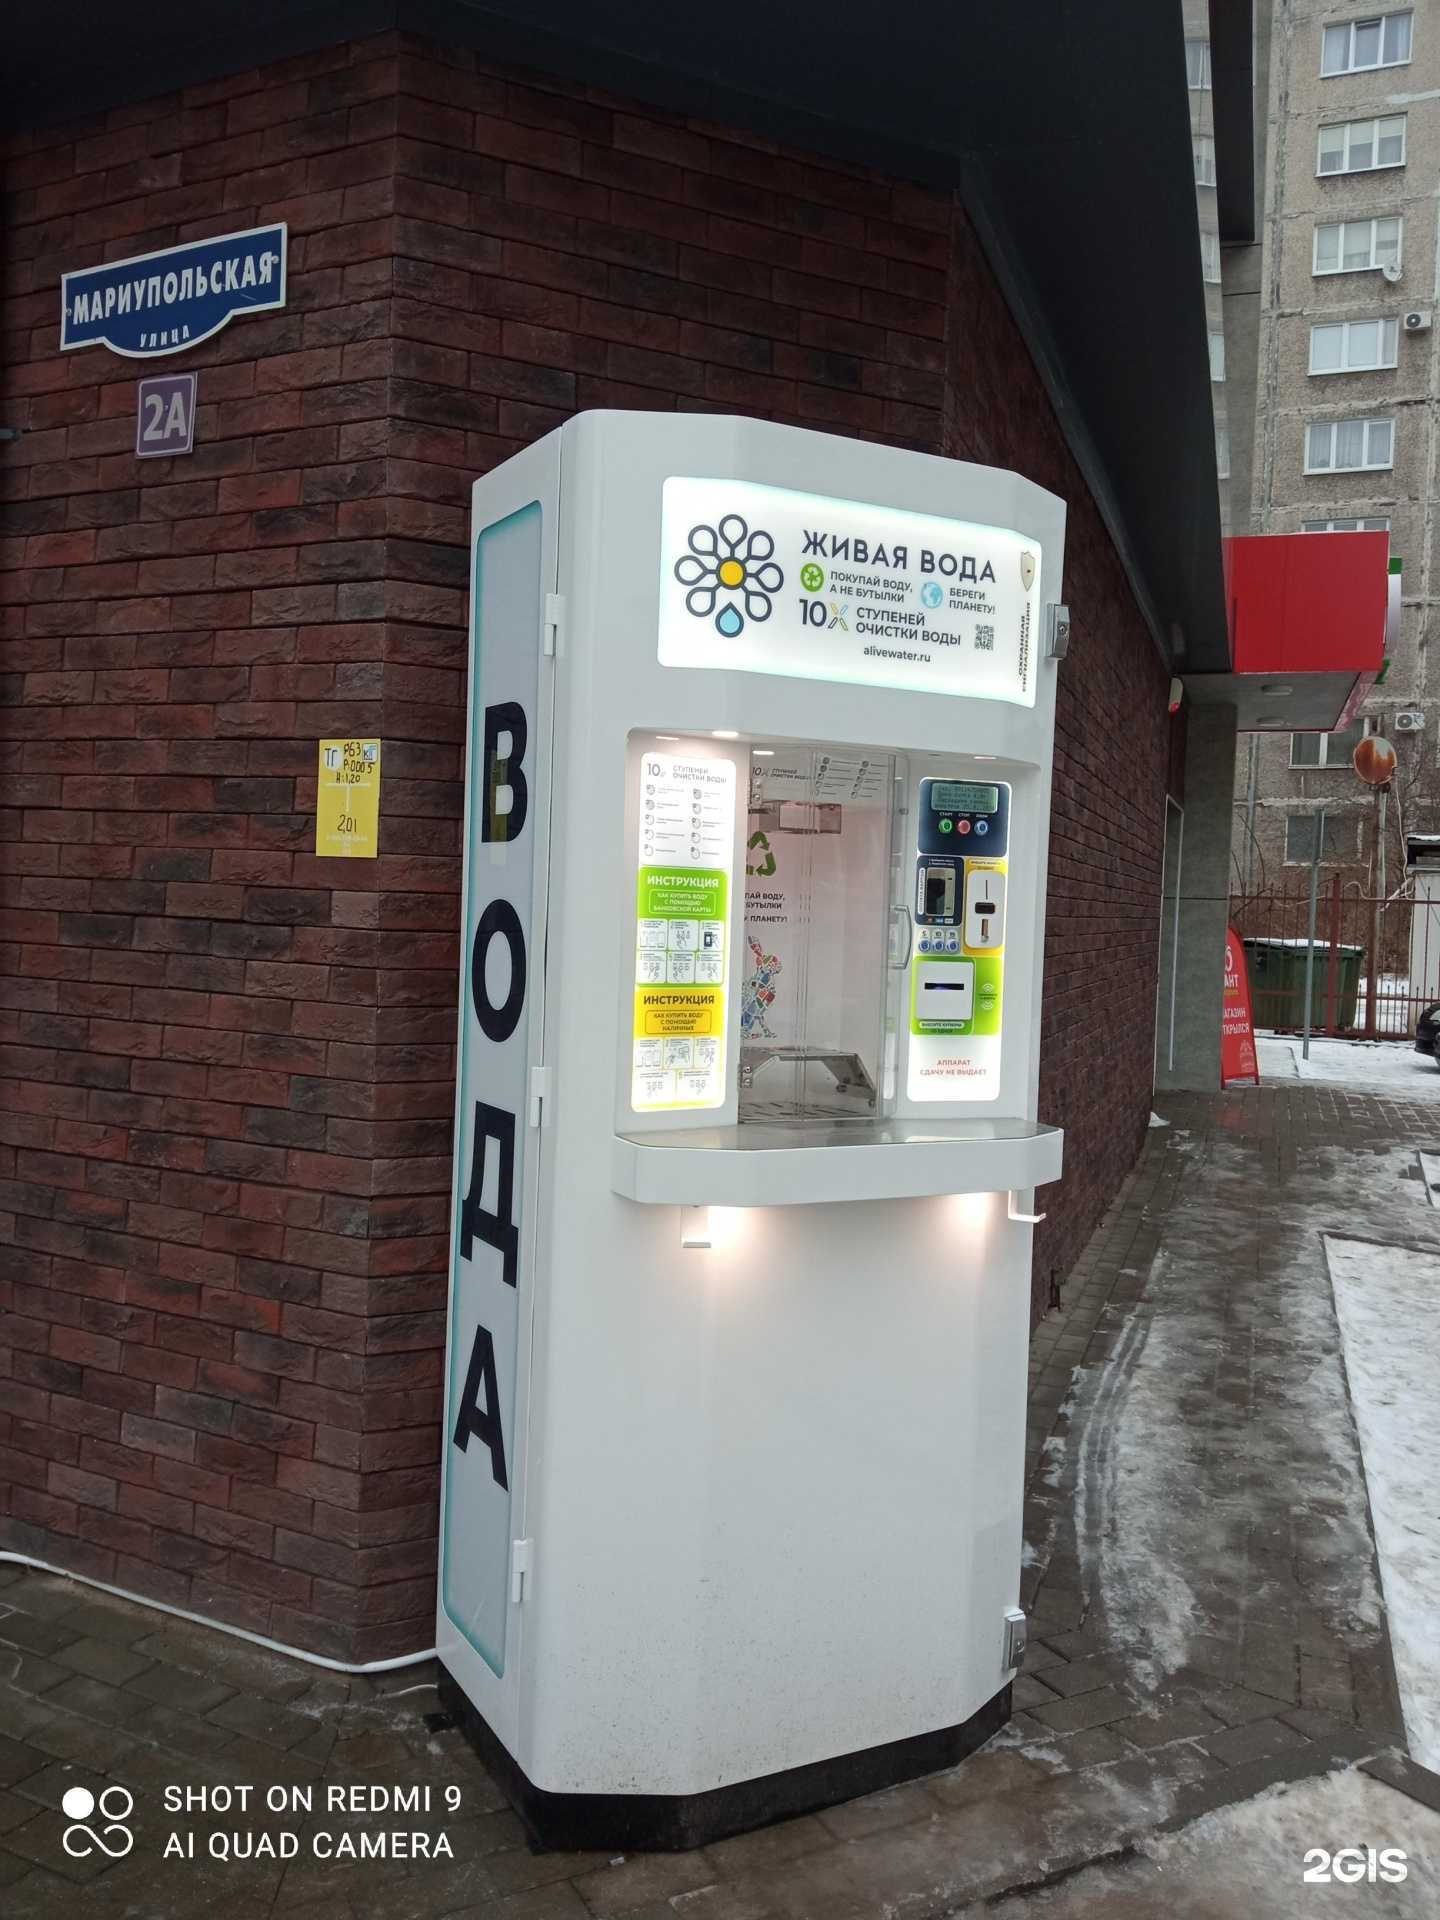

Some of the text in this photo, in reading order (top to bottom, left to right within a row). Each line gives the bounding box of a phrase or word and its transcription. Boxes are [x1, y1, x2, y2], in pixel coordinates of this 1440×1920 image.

[73, 251, 273, 325] МАРИУПОЛЬСКАЯ
[140, 325, 190, 348] УЛИЦА
[143, 391, 188, 441] 2А
[801, 530, 997, 584] ЖИВАЯ ВОДА
[830, 570, 913, 593] ПОКУПАЙ ВОДУ,
[829, 584, 905, 603] А НЕ БУТЫЛКИ
[949, 587, 986, 600] БЕРЕГИ
[949, 599, 997, 615] ПЛАНЕТУ!
[856, 606, 926, 627] СТУПЕНЕЙ
[855, 622, 962, 646] ОЧИСТКИ ВОДЫ
[863, 646, 932, 663] alivewater.ru
[647, 875, 719, 888] ИНСТРУКЦИЯ
[744, 891, 761, 900] ПАЙ
[1223, 974, 1239, 988] АНТ
[643, 995, 715, 1006] ИНСТРУКЦИЯ
[1223, 1007, 1246, 1019] АГАЗИН
[1222, 1023, 1250, 1035] ТКРЫЛСЯ
[937, 1059, 971, 1067] АППАРАТ
